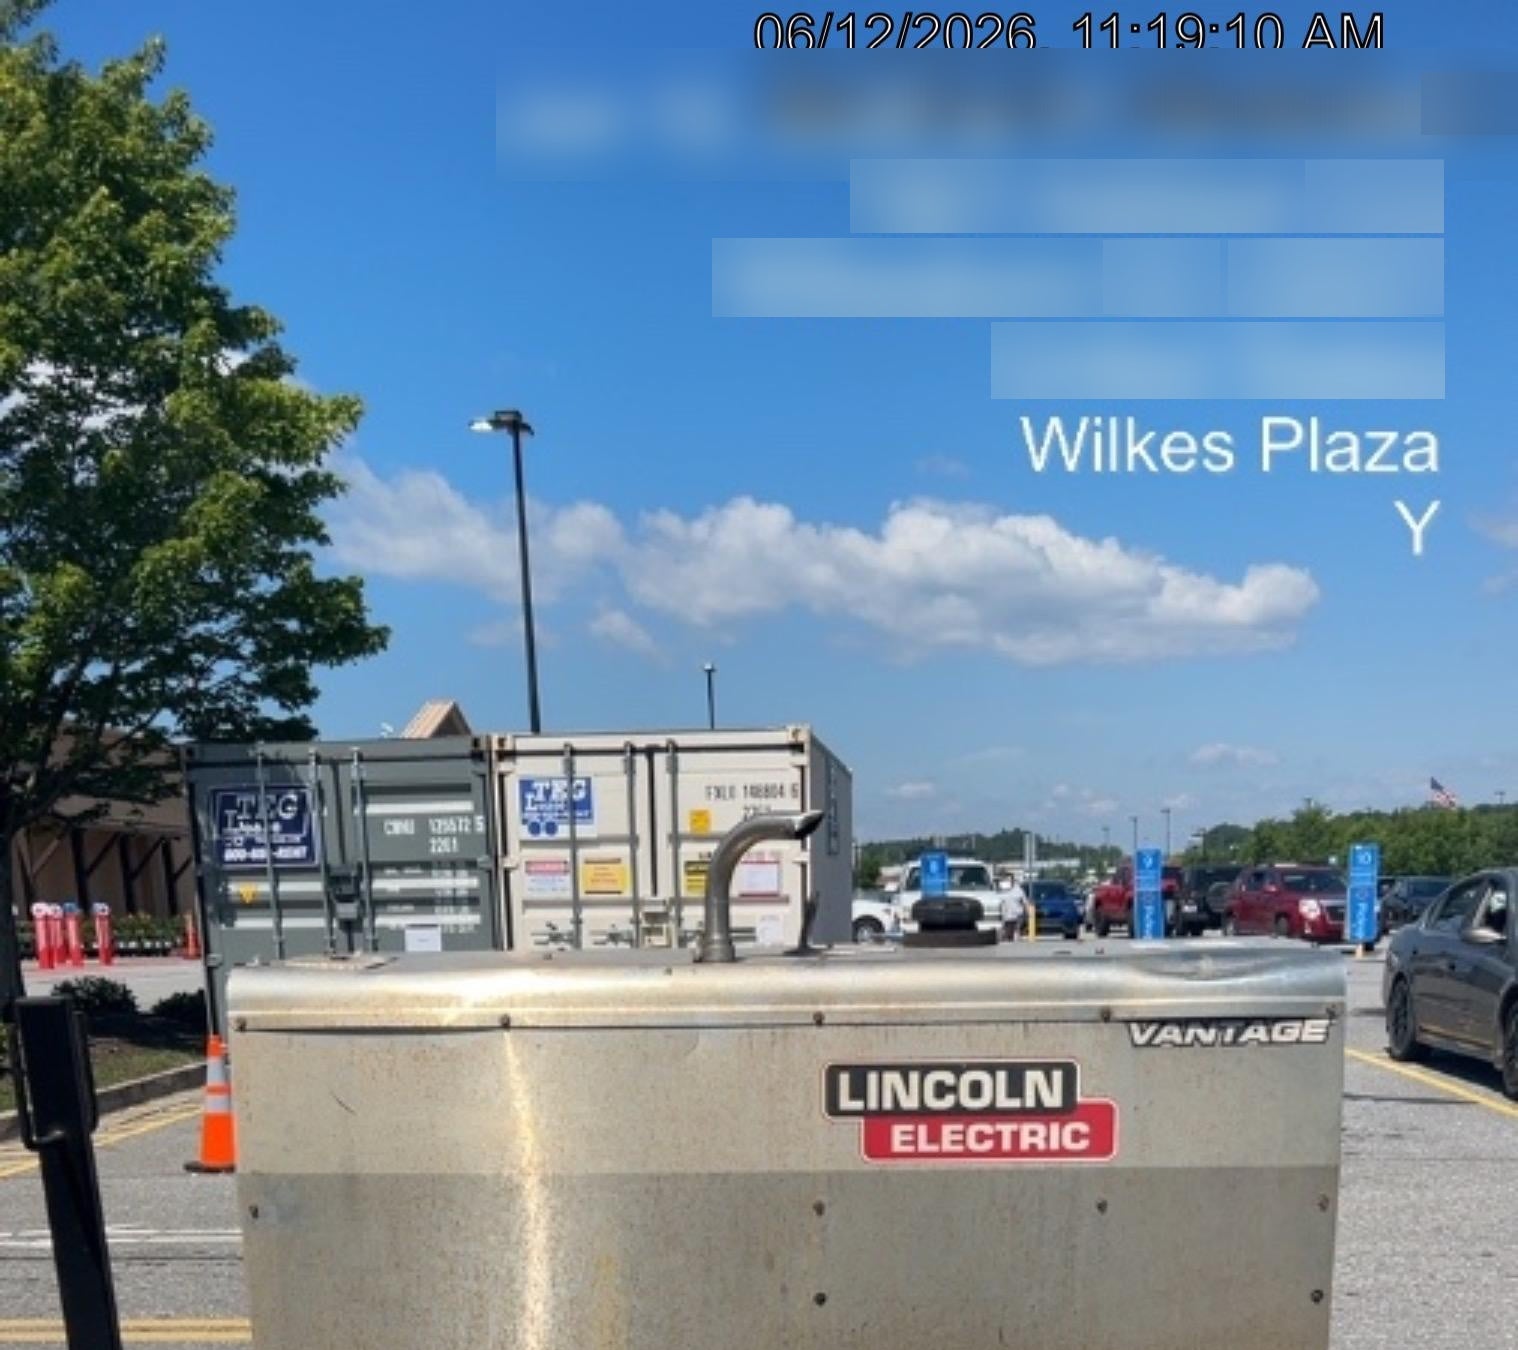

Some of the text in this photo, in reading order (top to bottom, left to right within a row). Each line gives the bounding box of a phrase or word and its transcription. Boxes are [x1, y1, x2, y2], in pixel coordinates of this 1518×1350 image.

[1128, 1018, 1332, 1047] VANTAGE
[837, 1069, 1064, 1111] LINCOLN
[890, 1122, 1091, 1154] ELECTRIC
